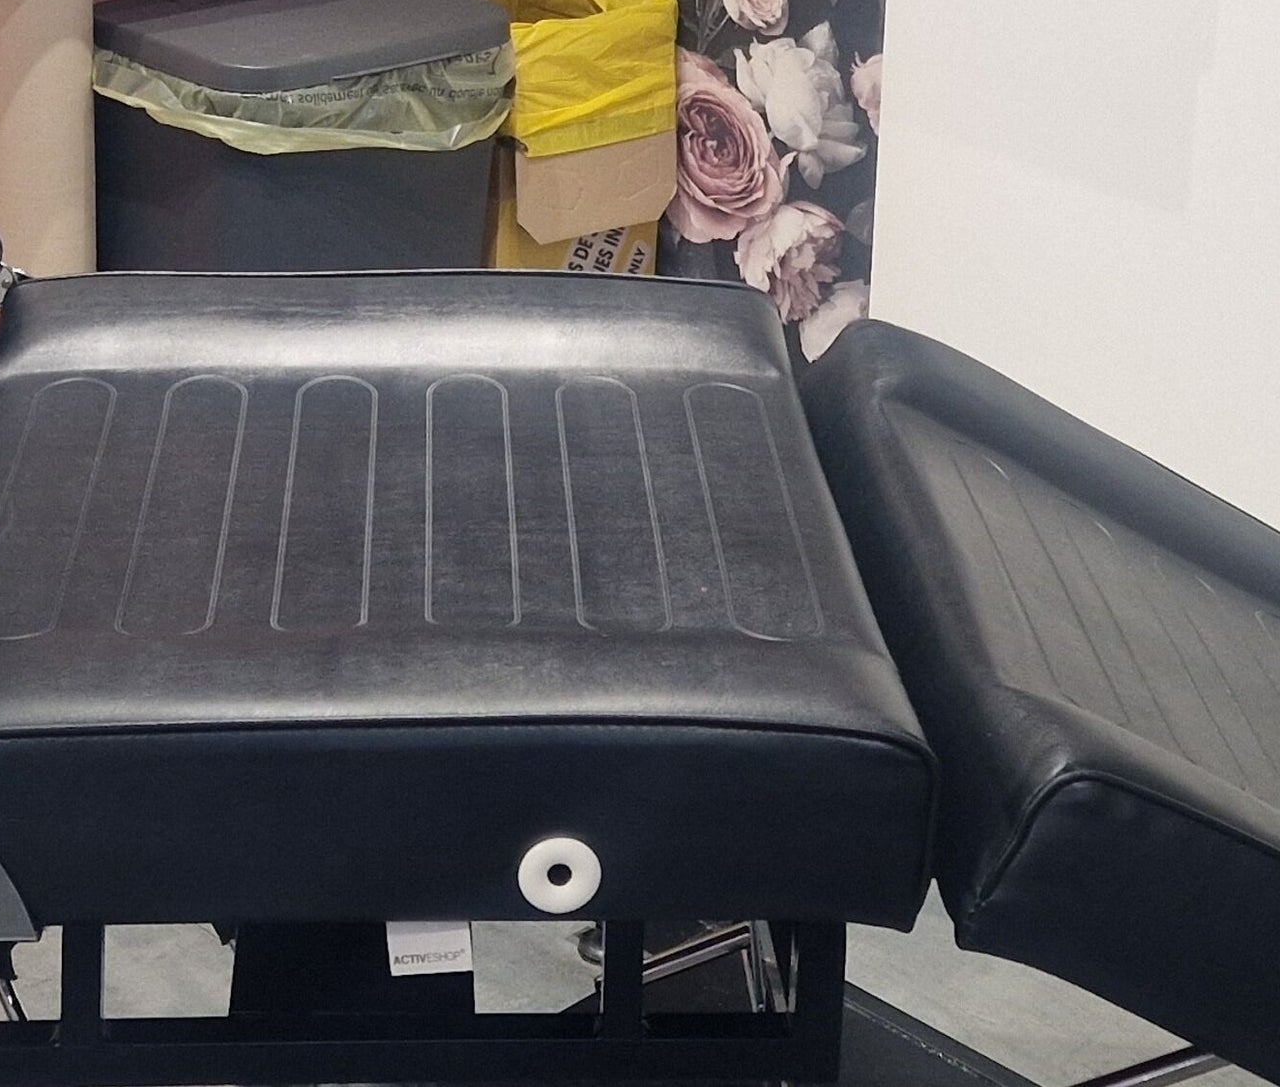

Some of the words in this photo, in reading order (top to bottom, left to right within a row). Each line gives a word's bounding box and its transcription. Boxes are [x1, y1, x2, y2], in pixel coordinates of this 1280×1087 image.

[573, 237, 594, 260] DE
[592, 248, 614, 272] IES
[604, 227, 625, 247] IN
